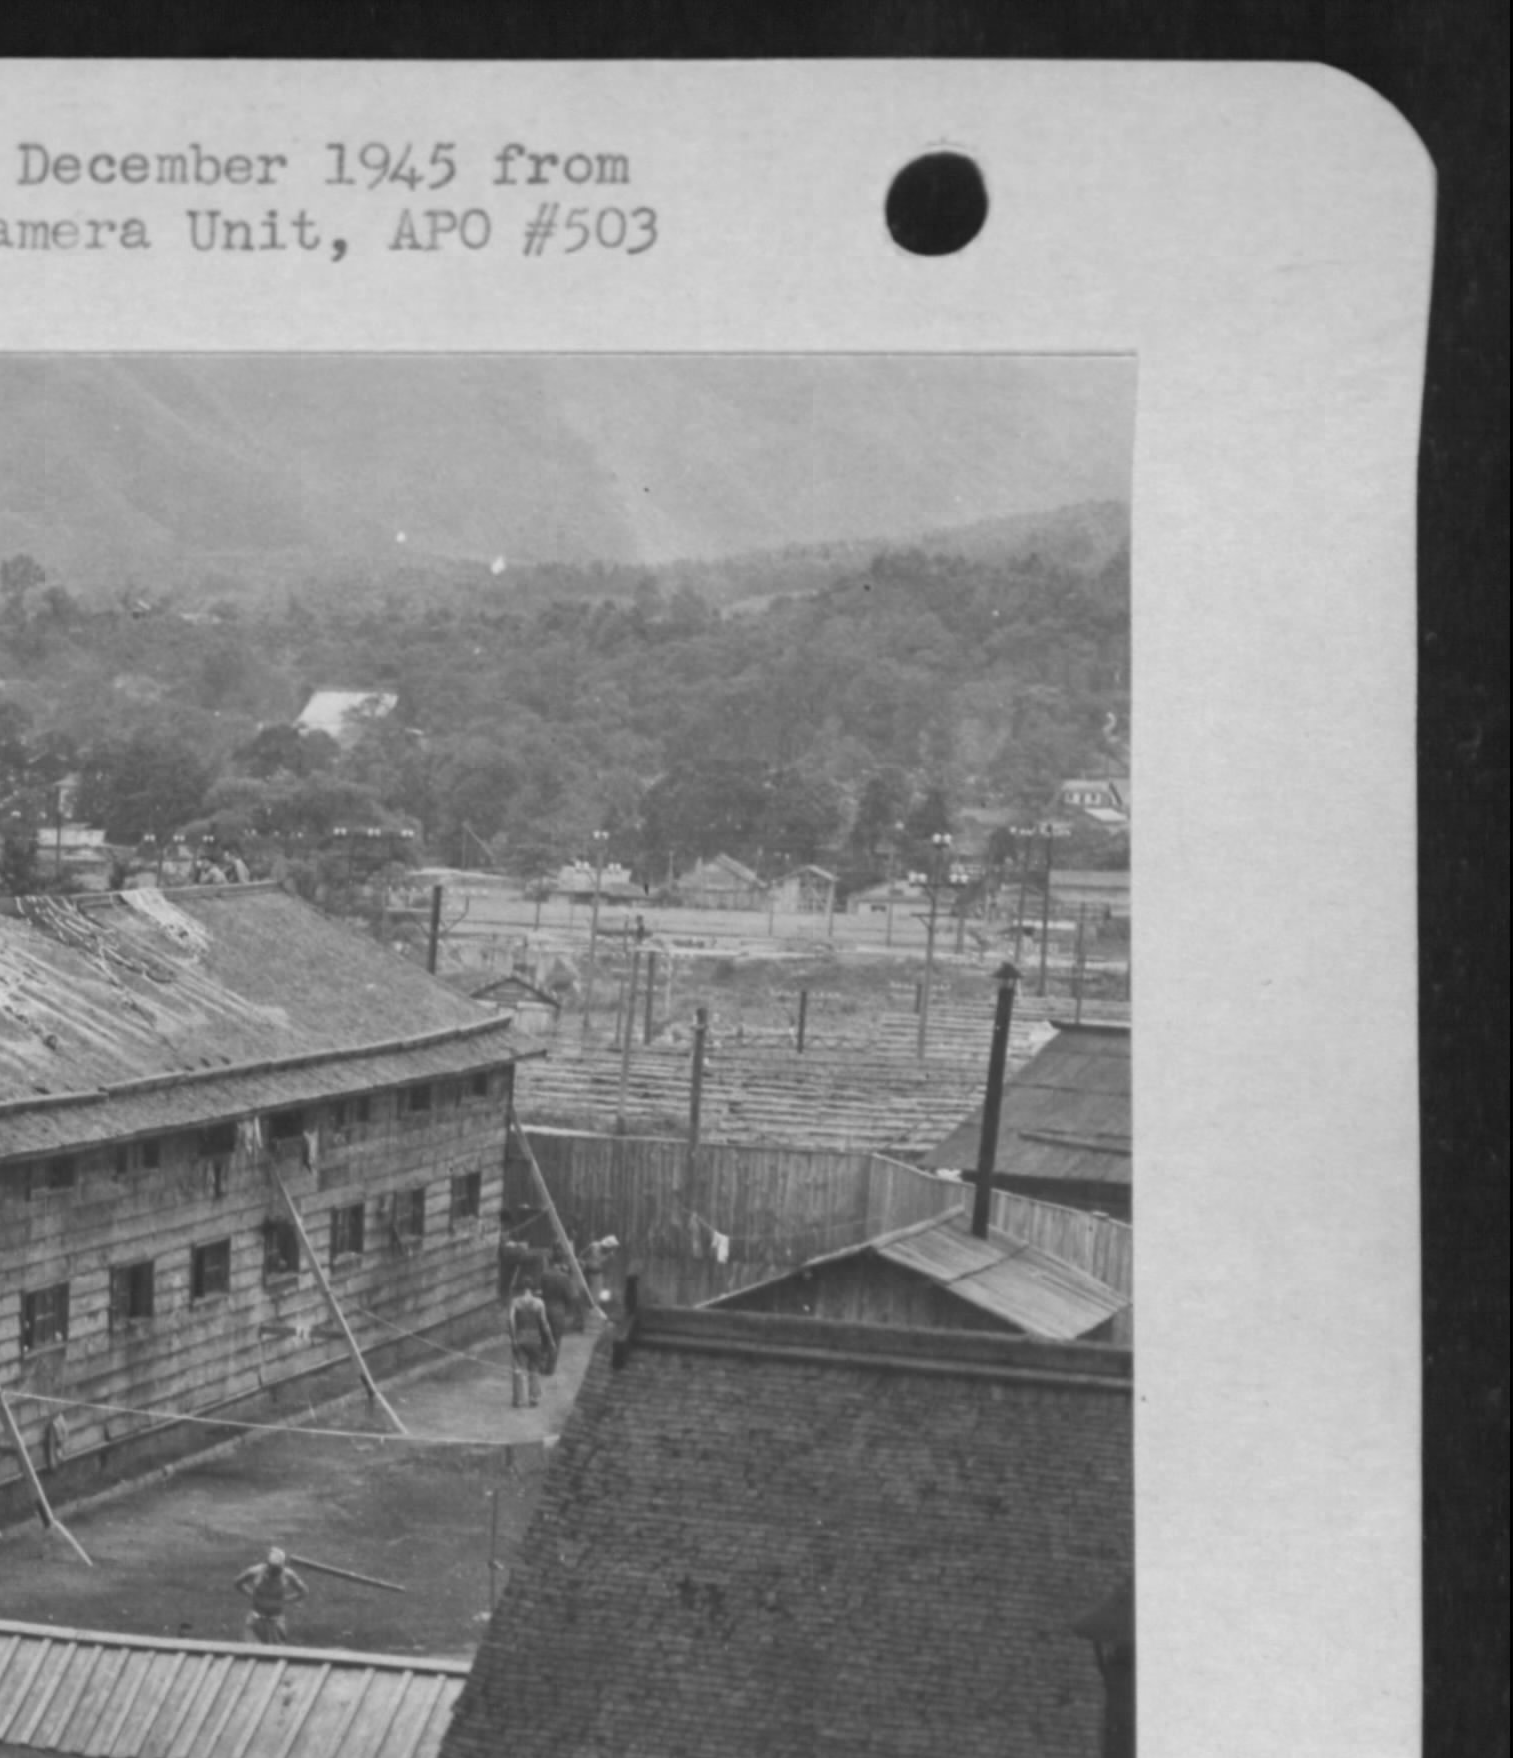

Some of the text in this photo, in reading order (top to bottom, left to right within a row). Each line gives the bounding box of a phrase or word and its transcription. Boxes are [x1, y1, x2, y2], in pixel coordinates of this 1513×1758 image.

[16, 142, 288, 186] December
[324, 142, 457, 191] 1945
[492, 143, 631, 185] from
[185, 208, 349, 262] Unit,
[388, 208, 491, 251] APO
[522, 202, 658, 256] #503
